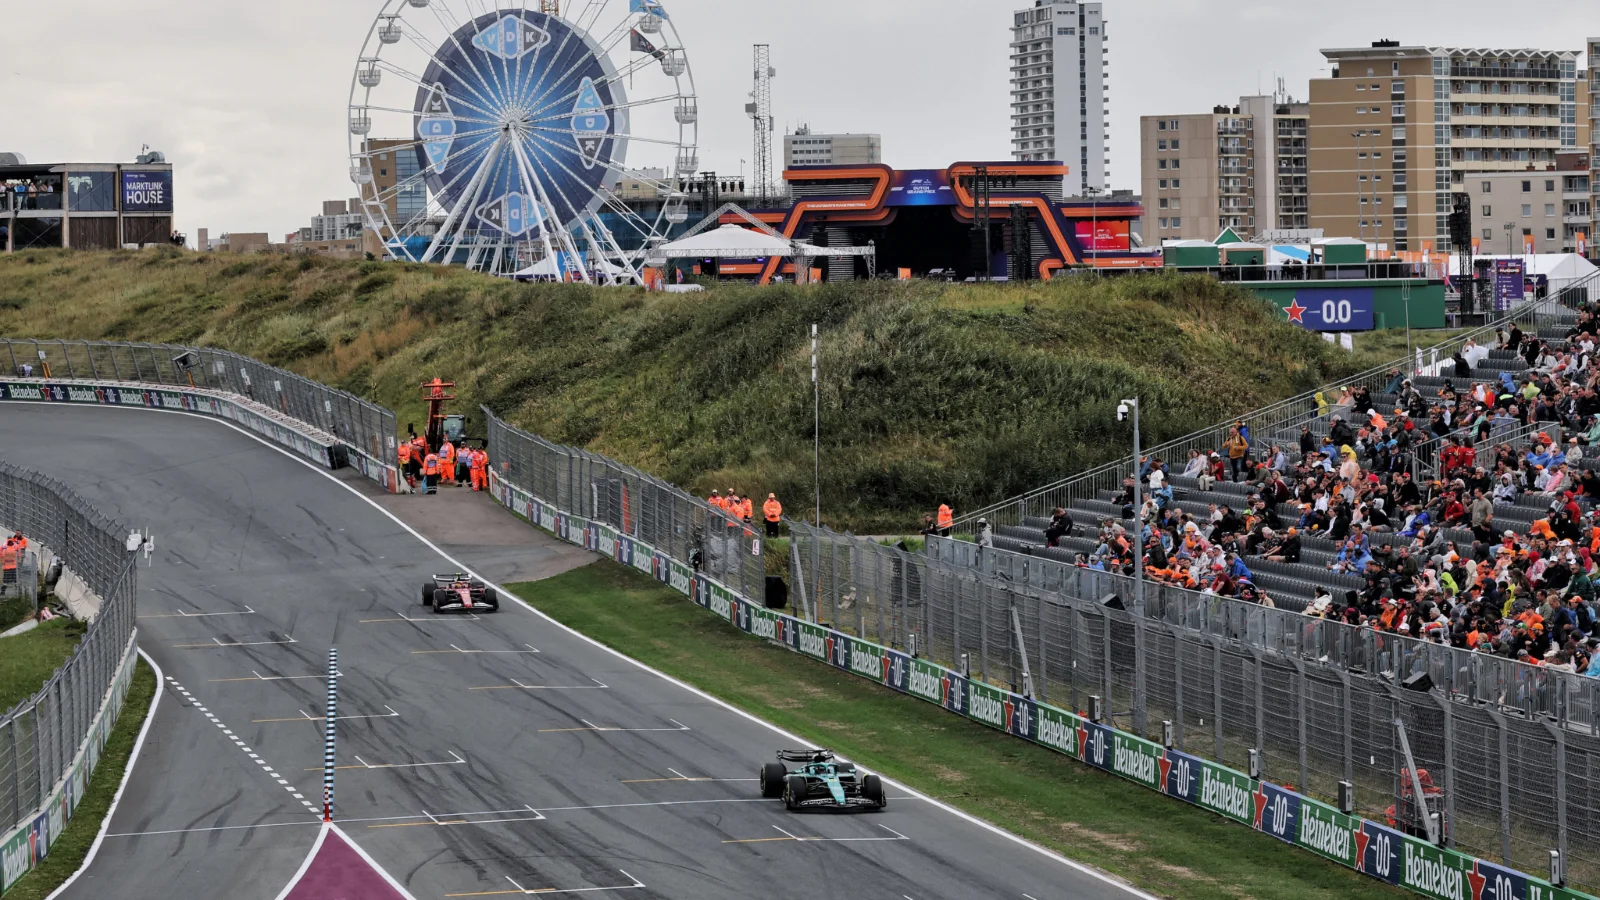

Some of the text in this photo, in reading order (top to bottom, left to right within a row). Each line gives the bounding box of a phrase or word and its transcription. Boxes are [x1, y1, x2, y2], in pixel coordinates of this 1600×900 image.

[126, 182, 163, 190] MARKTLINK
[126, 191, 164, 204] HOUSE
[1322, 299, 1351, 323] 0.0
[8, 384, 41, 399] Heineken
[67, 386, 97, 401] Heineken
[710, 585, 731, 620] Heineken
[750, 607, 776, 638] Heineken
[798, 624, 825, 658] Heineken
[850, 642, 880, 678] Heineken
[908, 661, 939, 700] Heineken
[969, 684, 1002, 725] Heineken
[1037, 708, 1074, 753] Heineken
[1093, 728, 1105, 765] 0.0
[1113, 735, 1155, 784] Heineken
[1177, 758, 1190, 798] 0.0
[1200, 766, 1249, 820] Heineken
[1272, 794, 1288, 836] 0.0
[1300, 803, 1350, 861] Heineken
[1375, 833, 1391, 878] 0.0
[1404, 842, 1464, 900] Heineken
